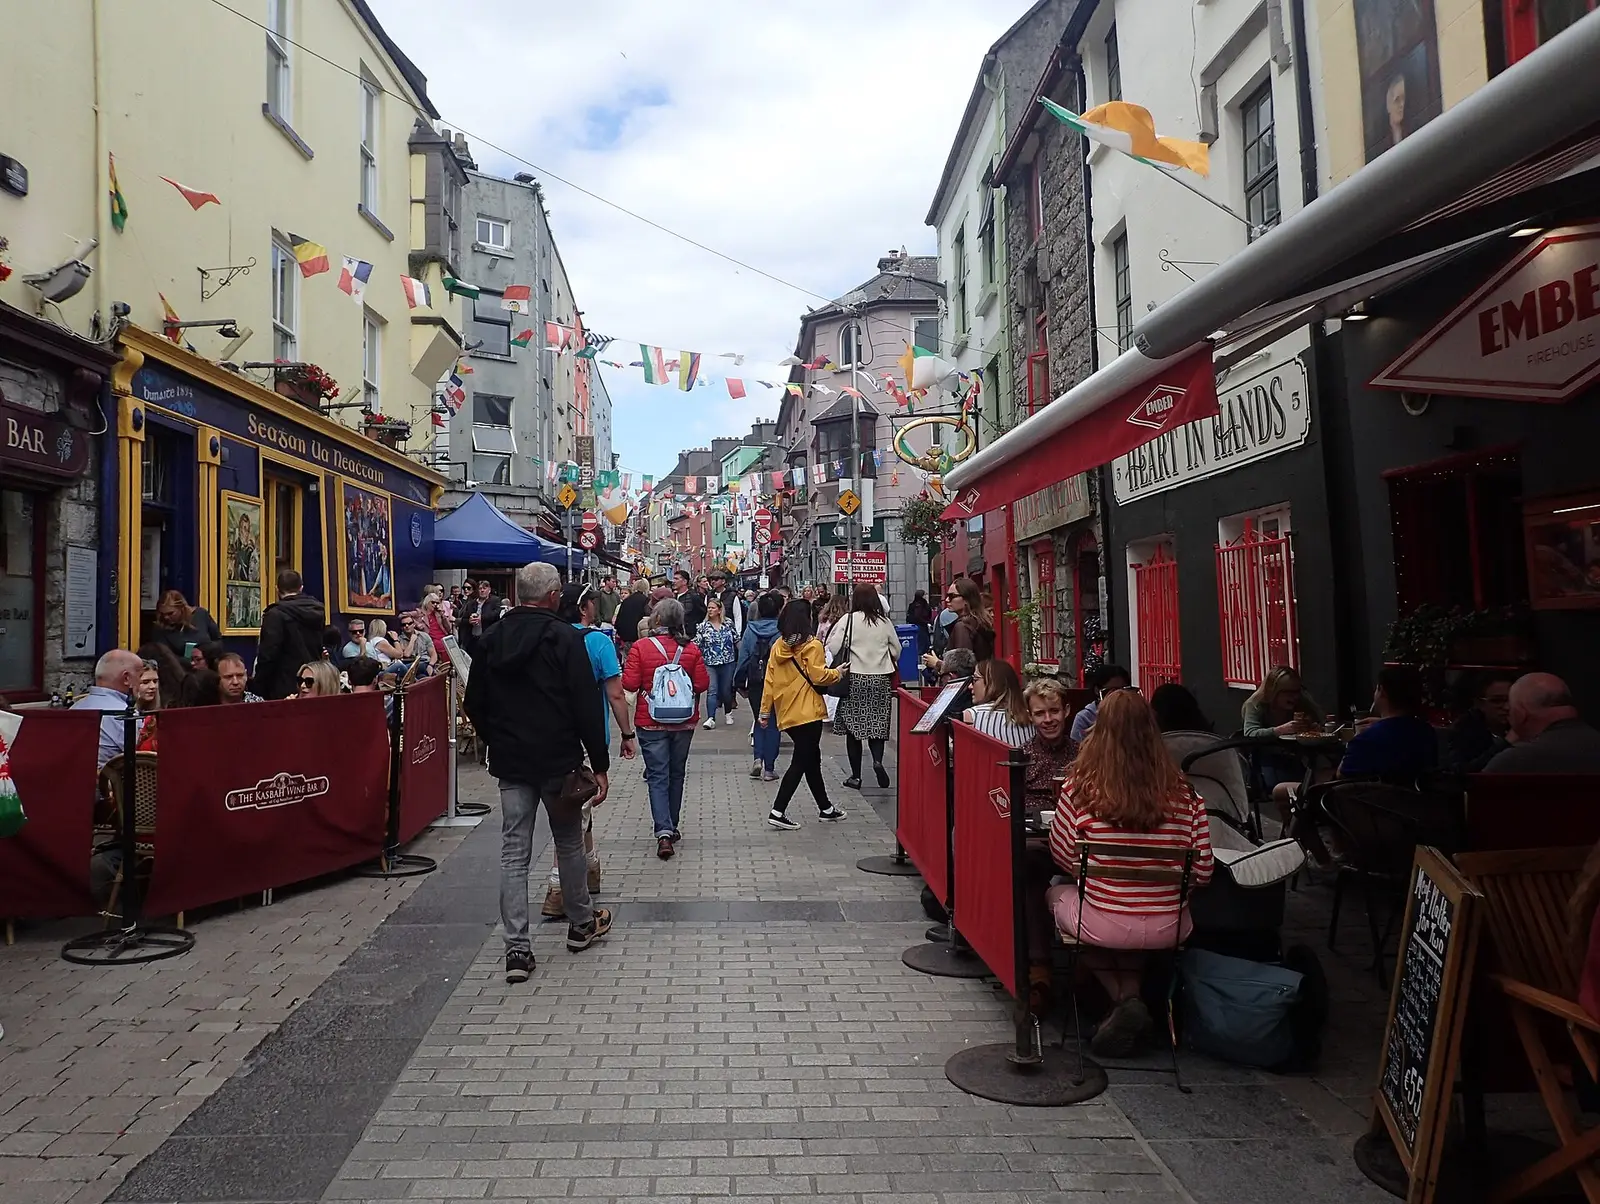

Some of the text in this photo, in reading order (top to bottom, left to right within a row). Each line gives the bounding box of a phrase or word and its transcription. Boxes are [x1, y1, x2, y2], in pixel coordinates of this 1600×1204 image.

[1478, 263, 1600, 358] EMBE
[1527, 333, 1596, 367] FIREHOUSE
[6, 417, 48, 455] BAR
[1116, 375, 1301, 492] 5 HEART IN HANDS 5
[238, 793, 253, 804] THE
[255, 787, 285, 801] KASBAH
[286, 785, 305, 796] WINE
[306, 783, 318, 793] BAR
[1416, 901, 1444, 955] for Two
[1404, 1066, 1424, 1117] €55
